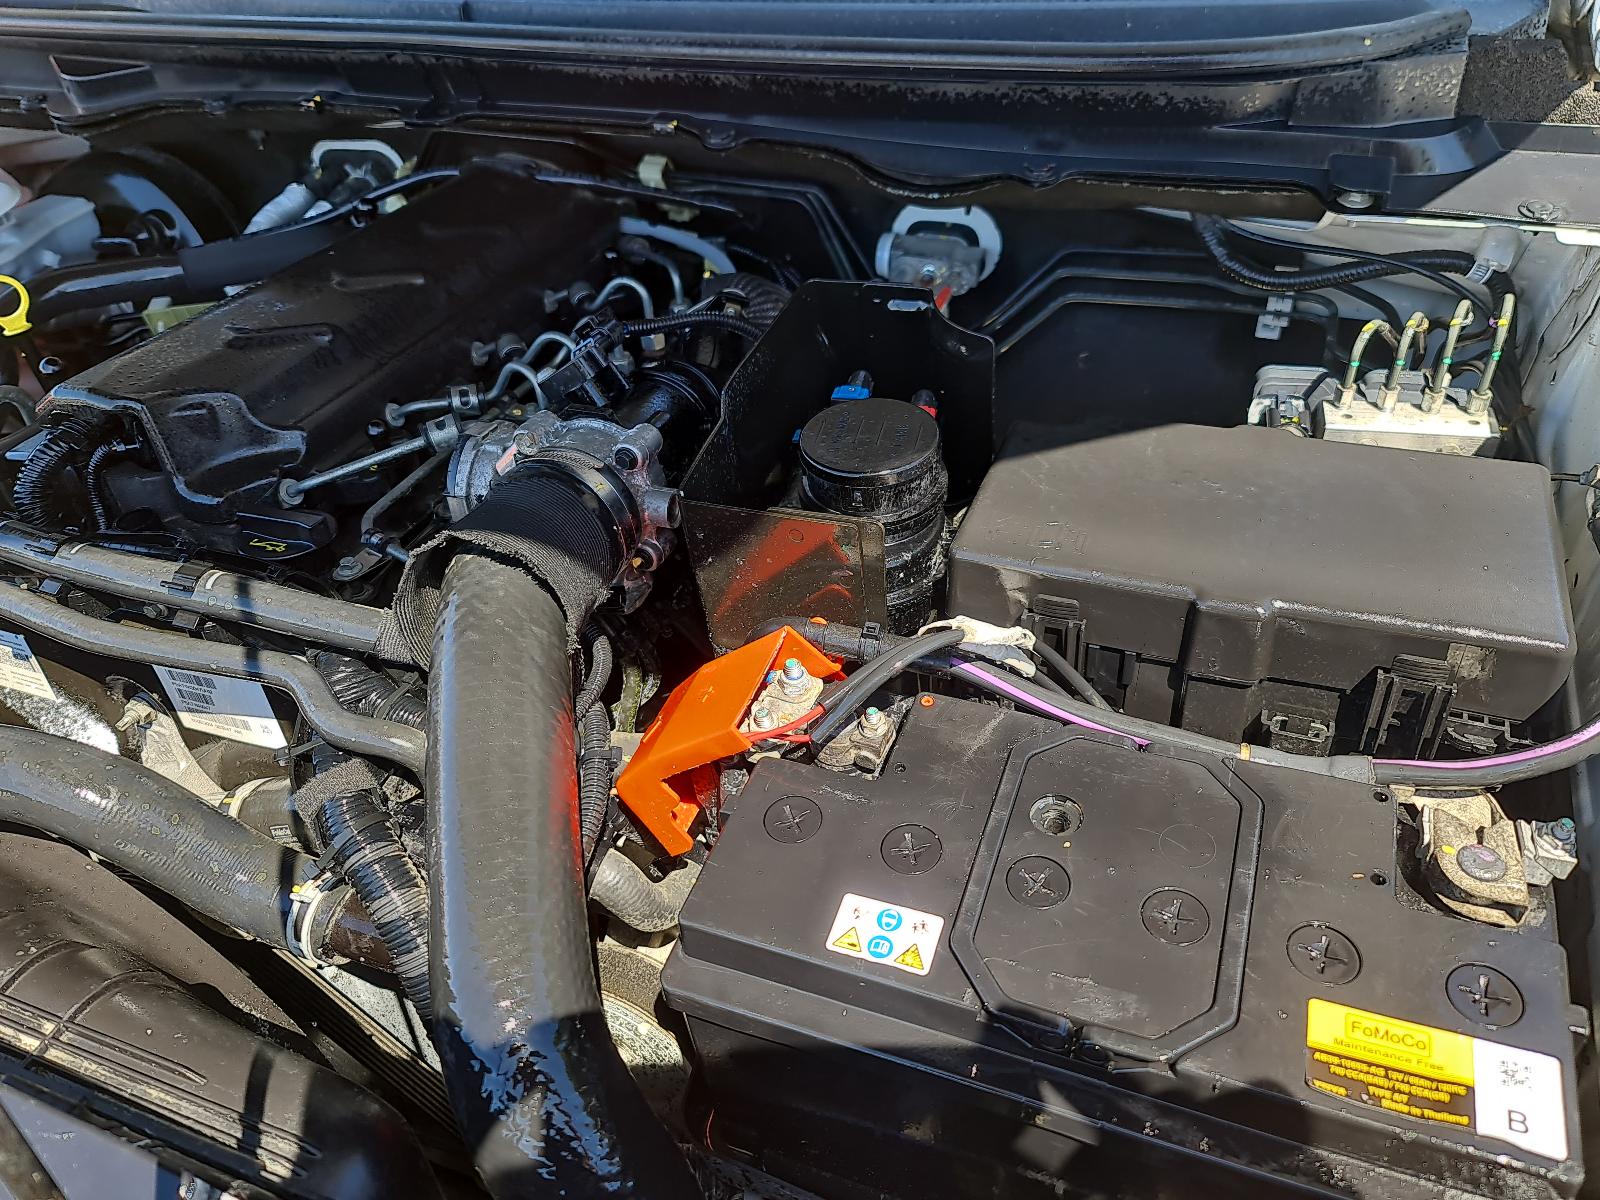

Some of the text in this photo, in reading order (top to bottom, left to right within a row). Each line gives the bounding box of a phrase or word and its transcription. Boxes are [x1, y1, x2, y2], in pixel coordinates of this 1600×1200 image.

[1351, 1020, 1427, 1051] FoMoCo
[1333, 1038, 1445, 1071] Maintenance Free
[1507, 1109, 1529, 1134] B
